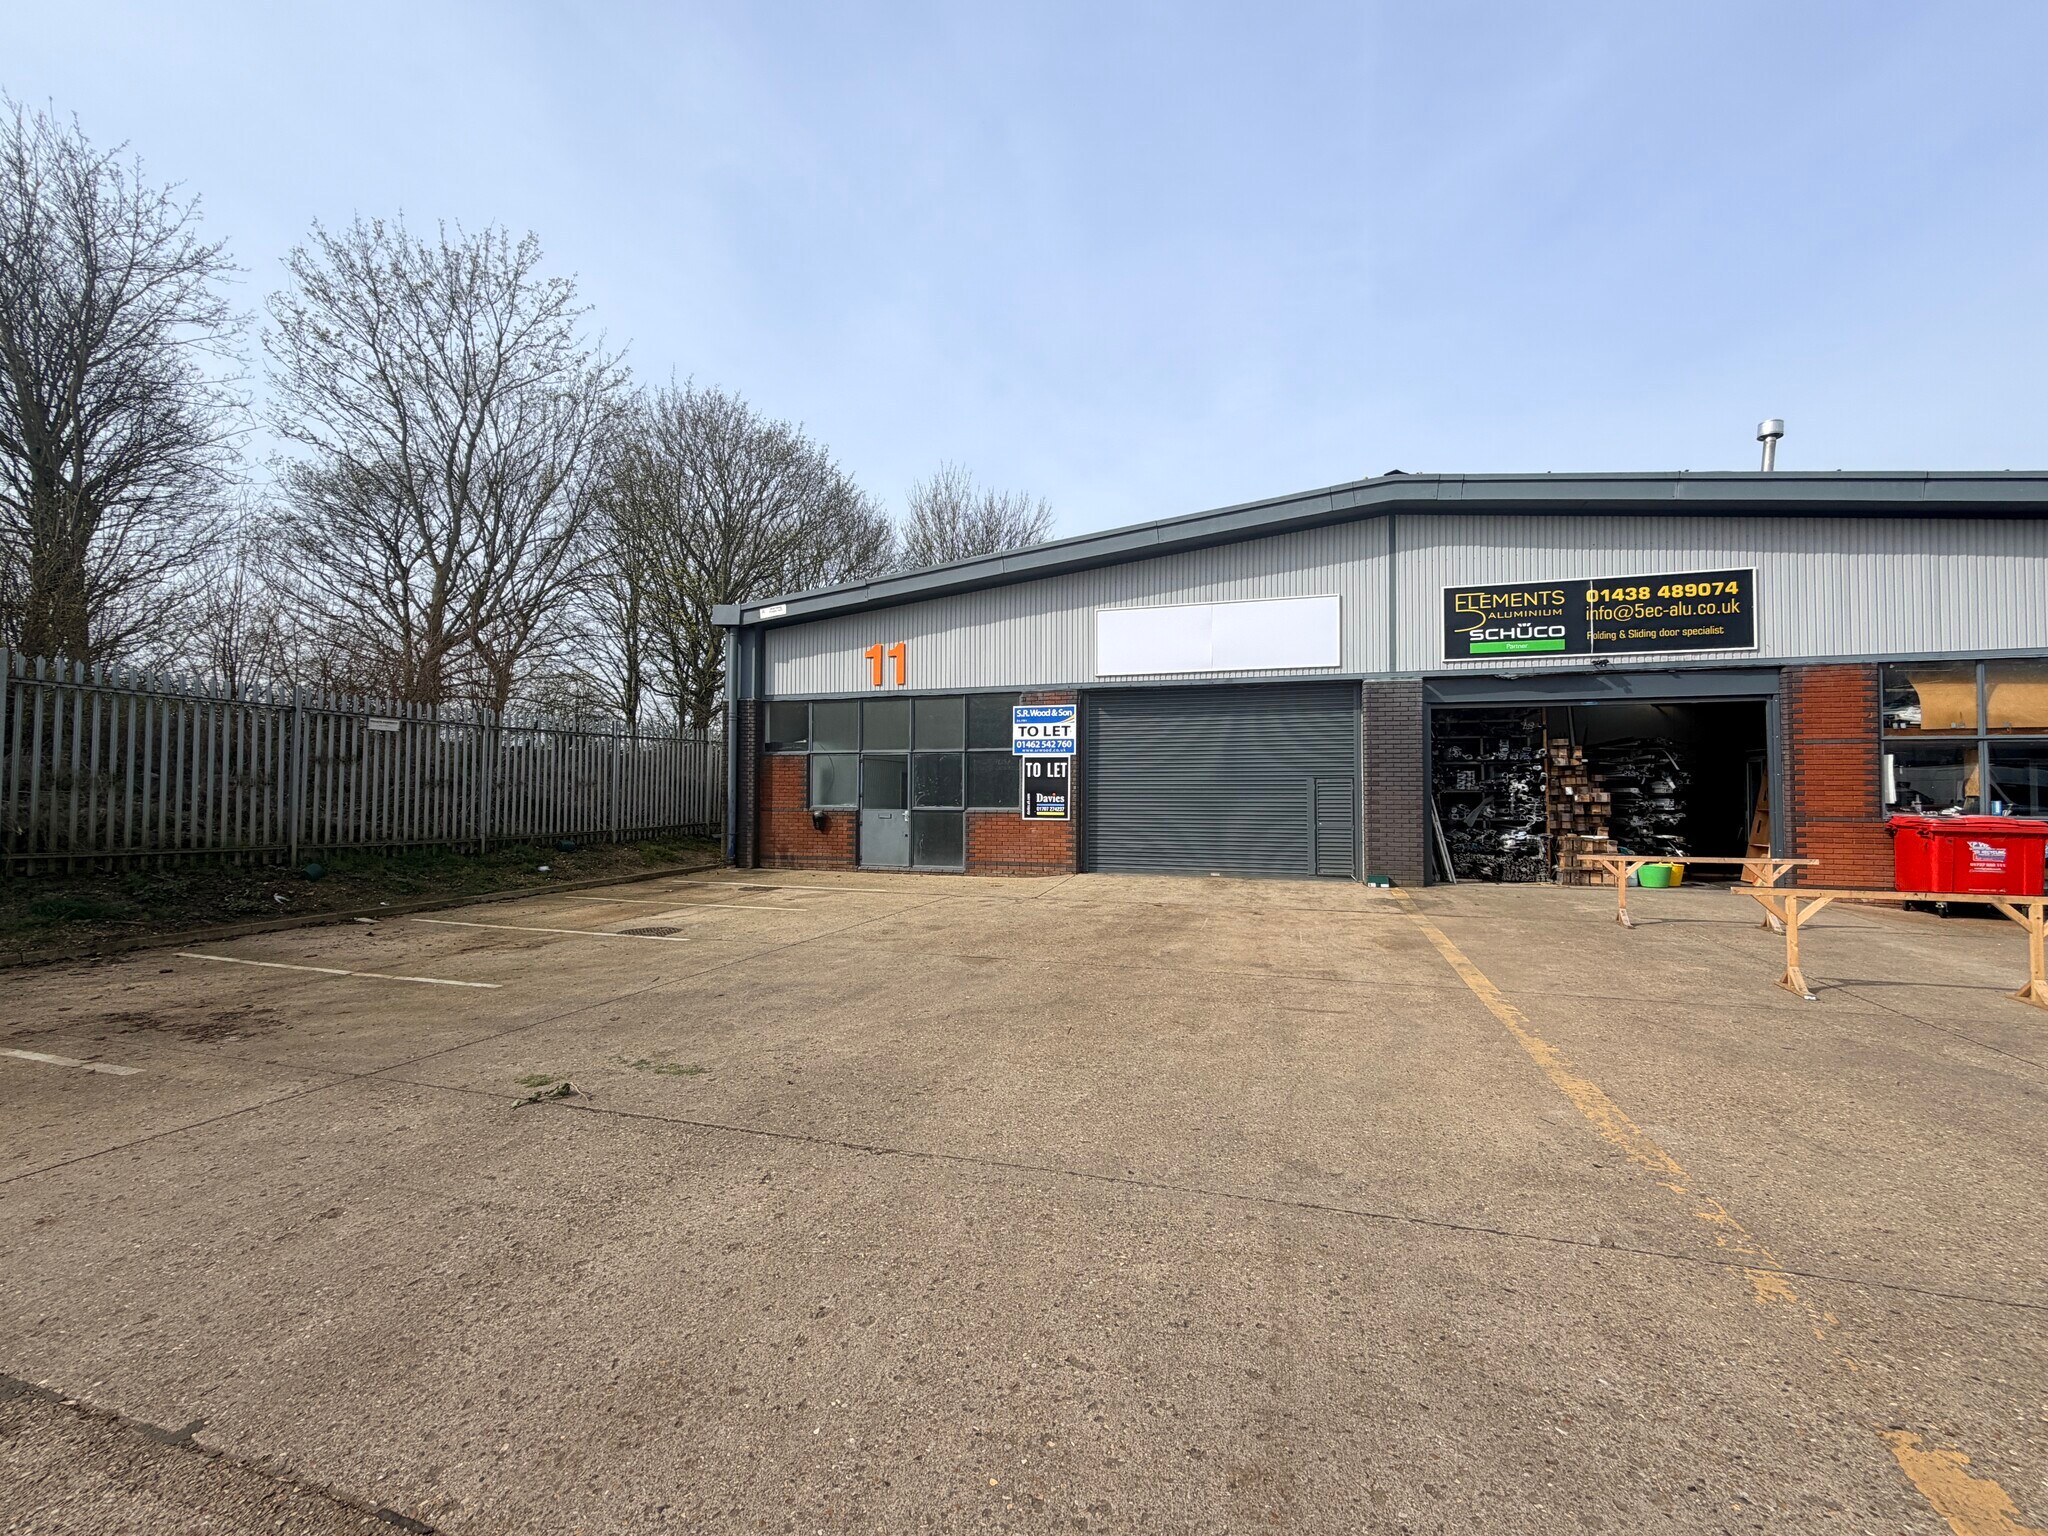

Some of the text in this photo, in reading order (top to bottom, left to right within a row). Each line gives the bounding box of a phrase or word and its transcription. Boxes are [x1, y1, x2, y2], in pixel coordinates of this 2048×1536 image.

[1586, 581, 1739, 603] 01438 489074
[1488, 609, 1562, 619] ALUMINIUM
[1586, 598, 1740, 621] info@5ec-alu.co.uk
[1587, 626, 1724, 641] Folding & Sliding door specialist
[865, 643, 905, 686] 11
[1030, 709, 1051, 717] Wood
[1051, 708, 1058, 716] &
[1058, 708, 1073, 716] Son
[1018, 725, 1071, 737] TO LET
[1016, 740, 1072, 748] 01462 542 760
[1025, 762, 1067, 778] TO LET
[1036, 792, 1065, 803] Davies
